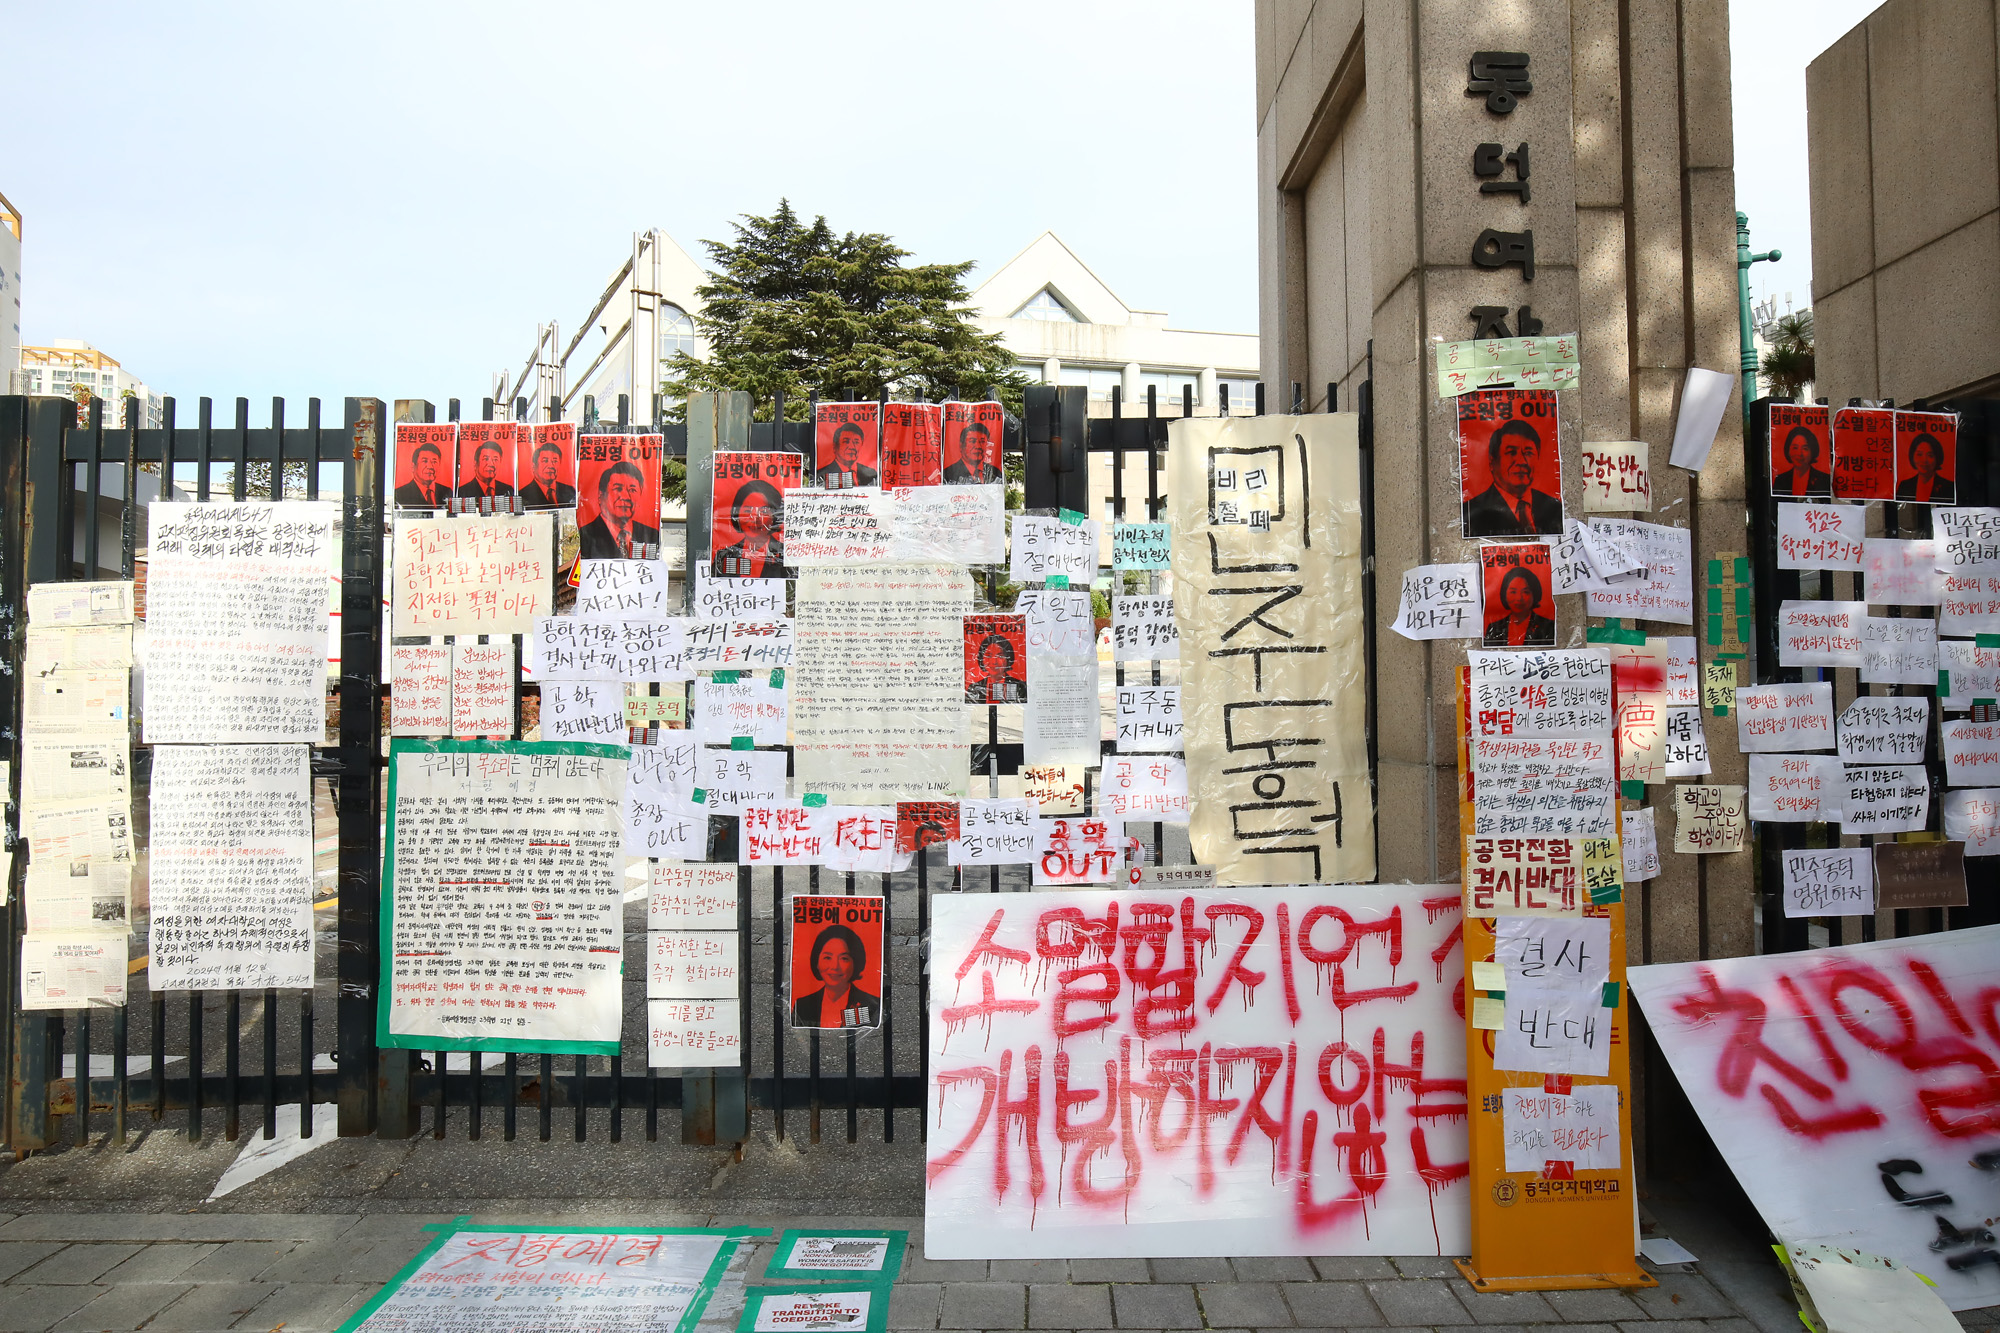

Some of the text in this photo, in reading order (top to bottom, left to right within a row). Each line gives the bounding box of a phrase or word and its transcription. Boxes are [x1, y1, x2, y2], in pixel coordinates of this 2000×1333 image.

[1448, 368, 1573, 392] 결사반대
[817, 412, 878, 423] 조원영 OUT
[885, 411, 941, 427] 소멸할지
[945, 411, 1003, 423] 조원영 OUT
[1459, 401, 1557, 420] 조원영 OUT
[1771, 413, 1828, 425] 김명애 OUT
[1836, 416, 1893, 432] 소멸할지
[1896, 421, 1954, 432] 김명애 OUT
[397, 432, 455, 443] 조원영 OUT
[460, 430, 516, 441] 조원영 OUT
[517, 430, 574, 443] 조원영 OUT
[914, 431, 941, 447] 언정
[1866, 437, 1893, 453] 언정
[580, 445, 662, 461] 조원영 OUT
[884, 450, 941, 465] 개방하지
[714, 463, 801, 479] 김명애 OUT
[1836, 456, 1893, 472] 개방하지
[883, 470, 927, 486] 않는다
[1217, 468, 1268, 492] 비리
[1618, 453, 1650, 499] 반대
[1835, 477, 1879, 493] 않는다
[894, 488, 913, 501] 또한
[817, 504, 837, 515] 우리가
[1217, 500, 1271, 533] 철폐
[1805, 510, 1842, 533] 학교는
[407, 525, 536, 561] 학교의 독단적인
[1113, 528, 1165, 544] 비민주적
[156, 538, 321, 558] 대해 타협을 배격한다
[1024, 551, 1091, 574] 절대반대
[1483, 553, 1550, 567] 김명애 OUT
[586, 562, 653, 589] 정신 좀
[408, 591, 459, 624] 진정한
[702, 593, 781, 618] 영원하라
[1118, 600, 1149, 618] 학생
[1406, 608, 1470, 630] 나와라
[620, 622, 672, 653] 총장은
[686, 623, 728, 643] 우리의
[1030, 629, 1087, 651] OUT
[1114, 624, 1139, 649] 동덕
[683, 645, 722, 662] 총장의
[618, 653, 684, 677] 나와라
[1478, 657, 1609, 679] 우리는 원한다
[1707, 667, 1735, 684] 독재
[1478, 684, 1609, 710] 총장은 약속을 성실히 이행
[1706, 687, 1735, 706] 총장
[628, 701, 680, 717] 민주 동덕
[552, 711, 624, 738] 절대반대
[1479, 708, 1530, 736] 면담에
[1580, 711, 1607, 730] 하라
[1582, 741, 1604, 761] 학교
[419, 752, 605, 780] 우리의 목소리는 멈추지 않는다
[1781, 758, 1811, 774] 우리가
[1872, 770, 1904, 783] 않는다
[1108, 794, 1188, 815] 절대반대
[1684, 787, 1723, 808] 학교의
[1851, 788, 1896, 803] 타협하지
[630, 800, 668, 827] 총장
[897, 808, 960, 822] 조원영 OUT
[1693, 800, 1743, 828] 주인은
[1576, 817, 1588, 835] 수
[747, 834, 821, 860] 결사반대
[961, 834, 1035, 858] 절대반대
[1475, 837, 1574, 864] 공학전환
[1583, 839, 1615, 861] 의견
[1041, 850, 1117, 878] OUT
[1788, 856, 1854, 885] 민주동덕
[653, 867, 736, 888] 민주동덕 각성하라
[1156, 869, 1213, 882] 동덕여대학보
[1586, 864, 1618, 890] 묵살
[1472, 867, 1576, 912] 결사반대
[1793, 885, 1868, 911] 영원하자
[651, 893, 692, 917] 공학추진
[793, 906, 883, 924] 김명애 OUT
[154, 916, 183, 928] 여성을
[212, 928, 239, 939] 하나의
[703, 938, 725, 957] 논의
[1519, 935, 1593, 978] 결사
[652, 962, 736, 984] 즉각 철회하라
[667, 1004, 716, 1022] 귀를 열고
[652, 1027, 740, 1052] 학생의 말을 들으라
[1519, 1008, 1596, 1051] 반대
[1671, 956, 2000, 1142] 친일
[927, 1028, 1303, 1205] 개방하지
[1513, 1129, 1548, 1152] 학교는
[1525, 1179, 1621, 1198] 동덕여자대학교
[1525, 1197, 1556, 1205] DONGDUK
